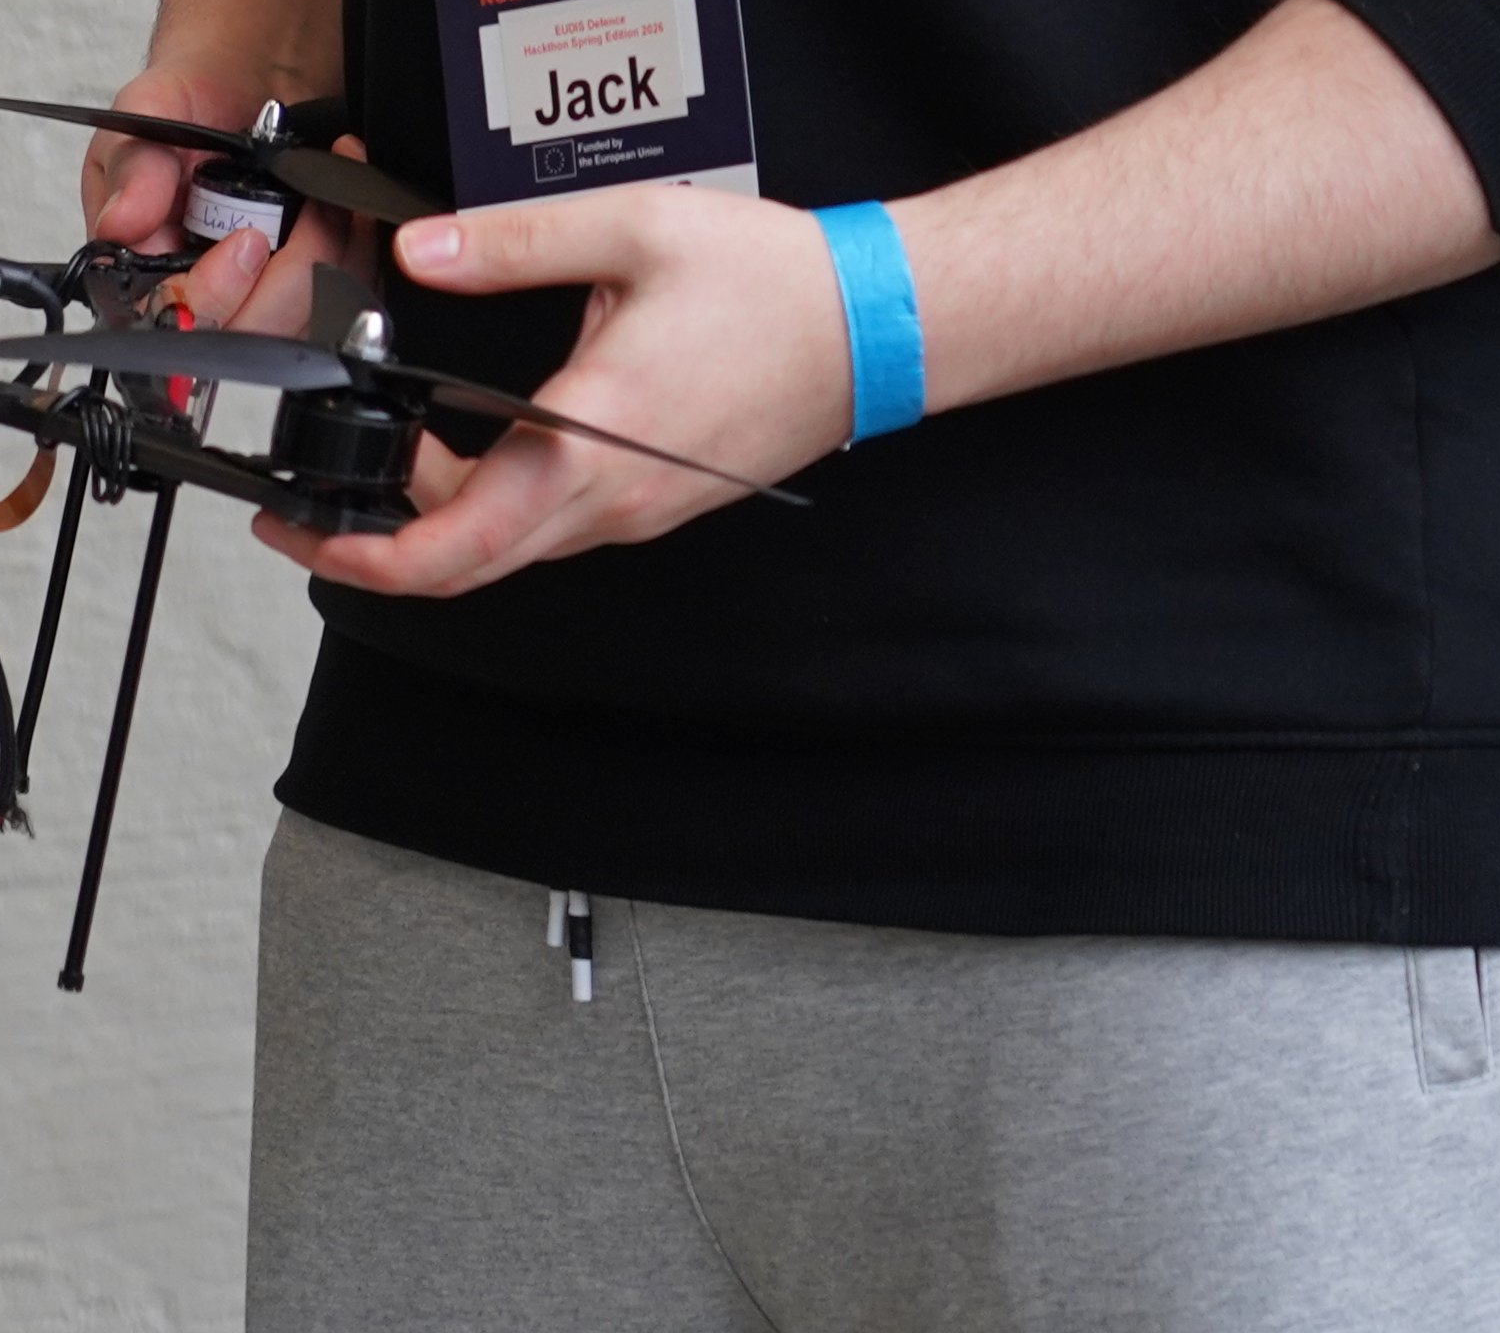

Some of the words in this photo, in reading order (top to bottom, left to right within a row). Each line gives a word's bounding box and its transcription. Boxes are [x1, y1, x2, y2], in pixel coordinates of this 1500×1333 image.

[554, 21, 585, 36] EUDIS
[587, 16, 626, 30] Defence
[524, 40, 569, 57] Hackthon
[571, 35, 603, 50] Spring
[605, 28, 639, 43] Edition
[642, 21, 664, 36] 2026
[535, 55, 660, 126] Jack
[577, 138, 611, 153] Funded
[612, 137, 623, 150] by
[579, 156, 593, 169] the
[594, 149, 636, 166] European
[637, 145, 664, 158] Union
